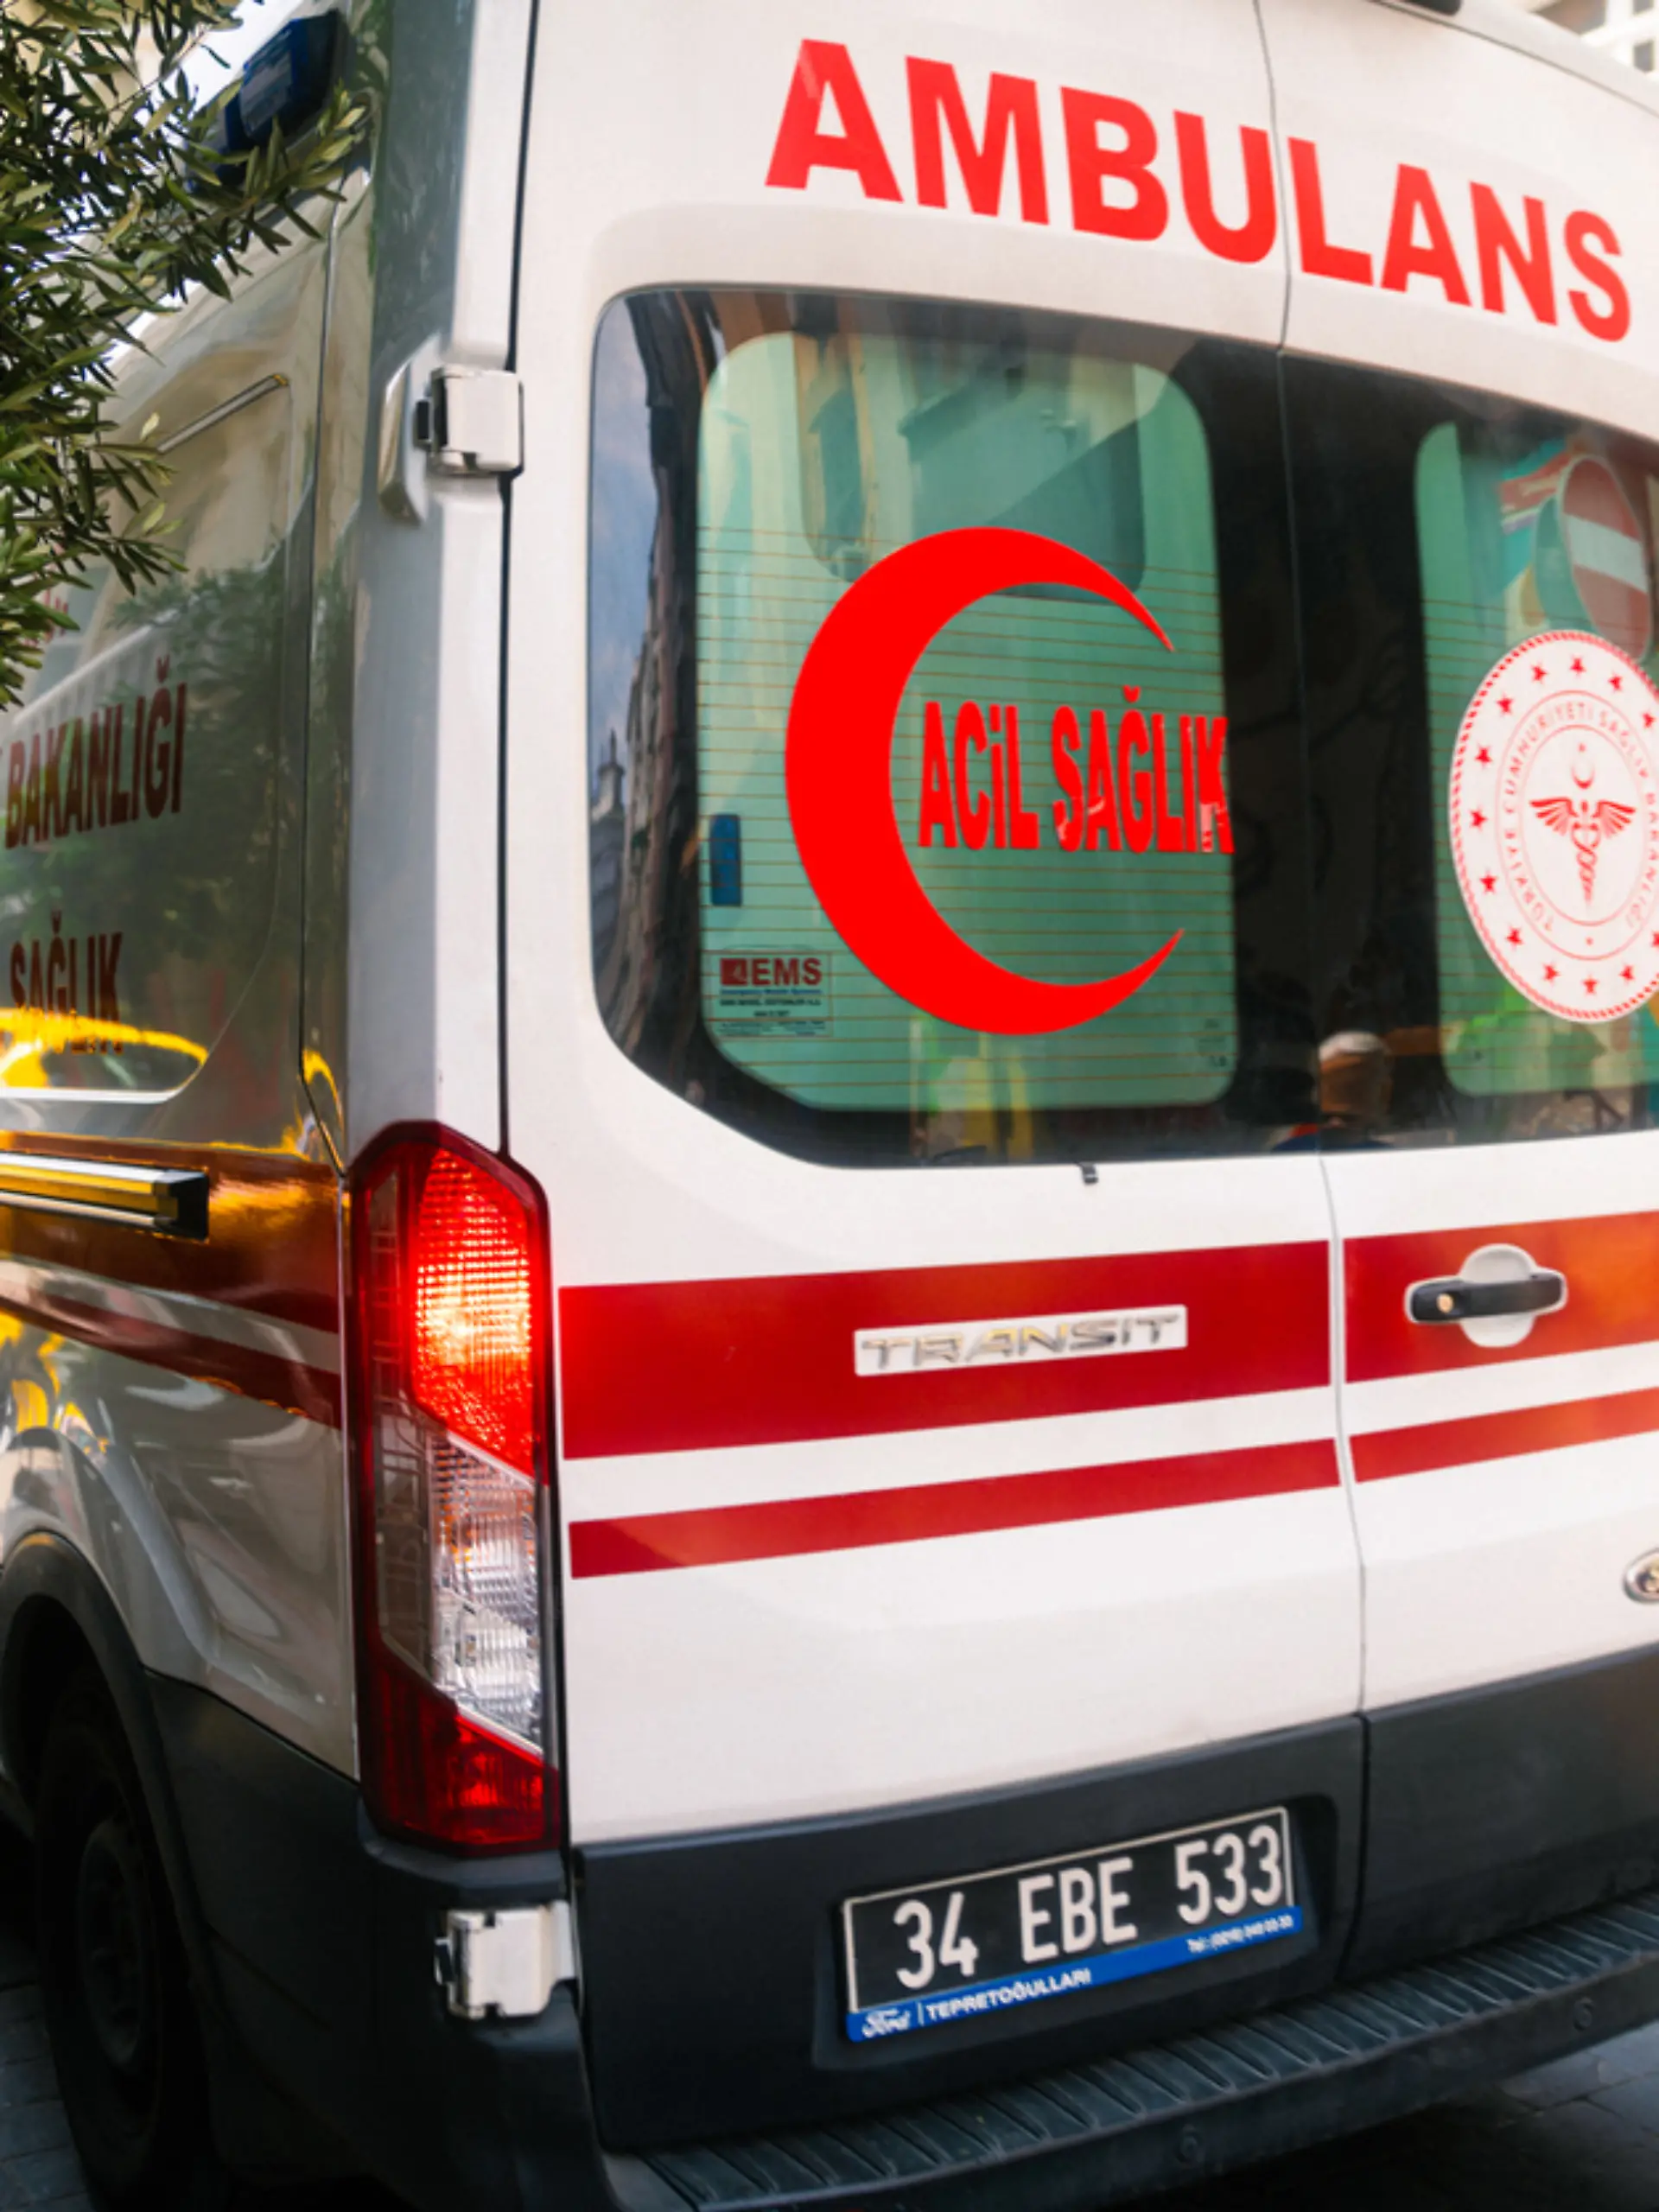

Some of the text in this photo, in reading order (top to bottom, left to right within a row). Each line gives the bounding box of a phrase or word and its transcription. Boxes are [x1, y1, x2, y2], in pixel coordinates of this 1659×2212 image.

[765, 38, 1631, 342] AMBULANS
[5, 654, 187, 849] BAKANLIĞI
[1051, 684, 1235, 855] SAĞLIK
[751, 957, 823, 986] EMS
[861, 1314, 1179, 1370] TRANSIT
[893, 1824, 1284, 1989] 34 EBE 533
